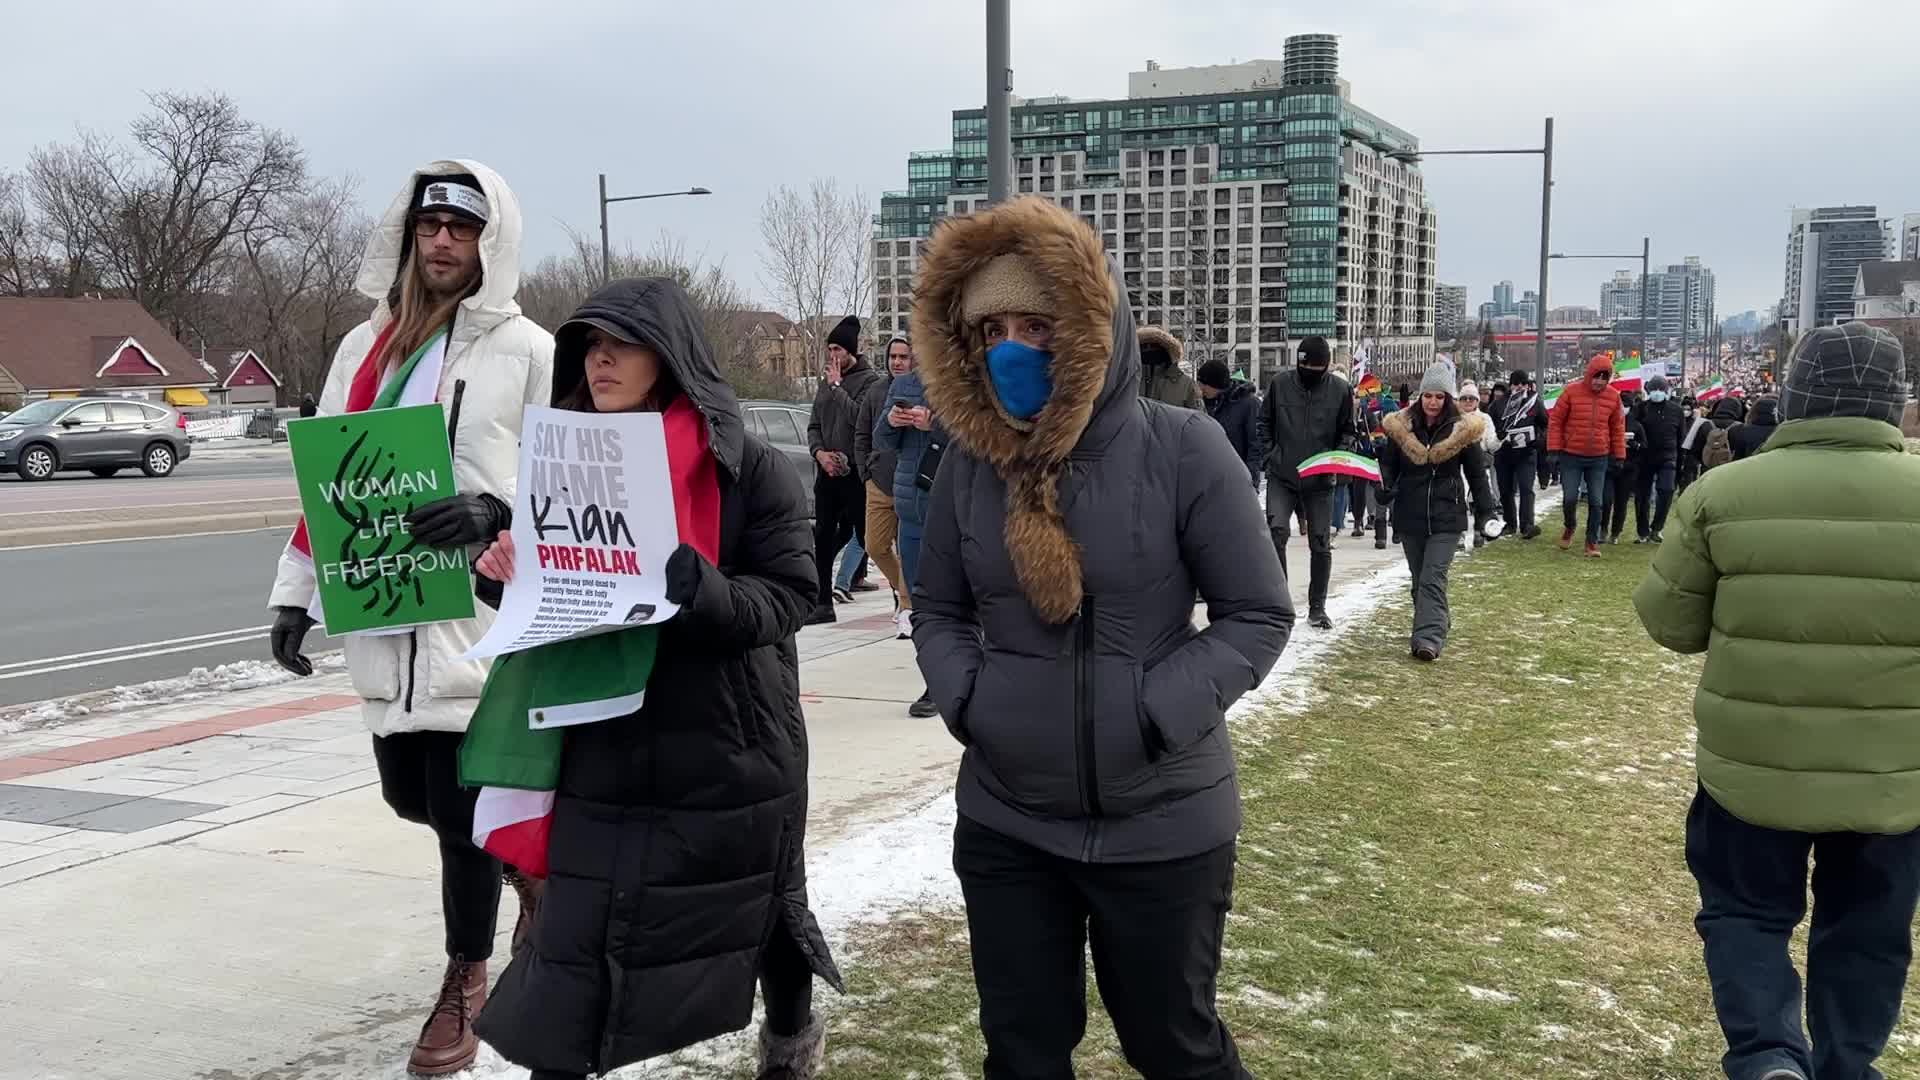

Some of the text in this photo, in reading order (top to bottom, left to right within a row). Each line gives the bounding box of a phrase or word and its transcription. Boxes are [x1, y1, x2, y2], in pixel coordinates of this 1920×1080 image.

[533, 421, 623, 463] SAY HIS
[318, 469, 438, 504] WOMAN
[530, 458, 629, 509] NAME
[356, 513, 413, 539] LIFE
[530, 486, 636, 547] Kian
[322, 548, 463, 585] FREEDOM
[536, 544, 642, 576] PIRFALAK
